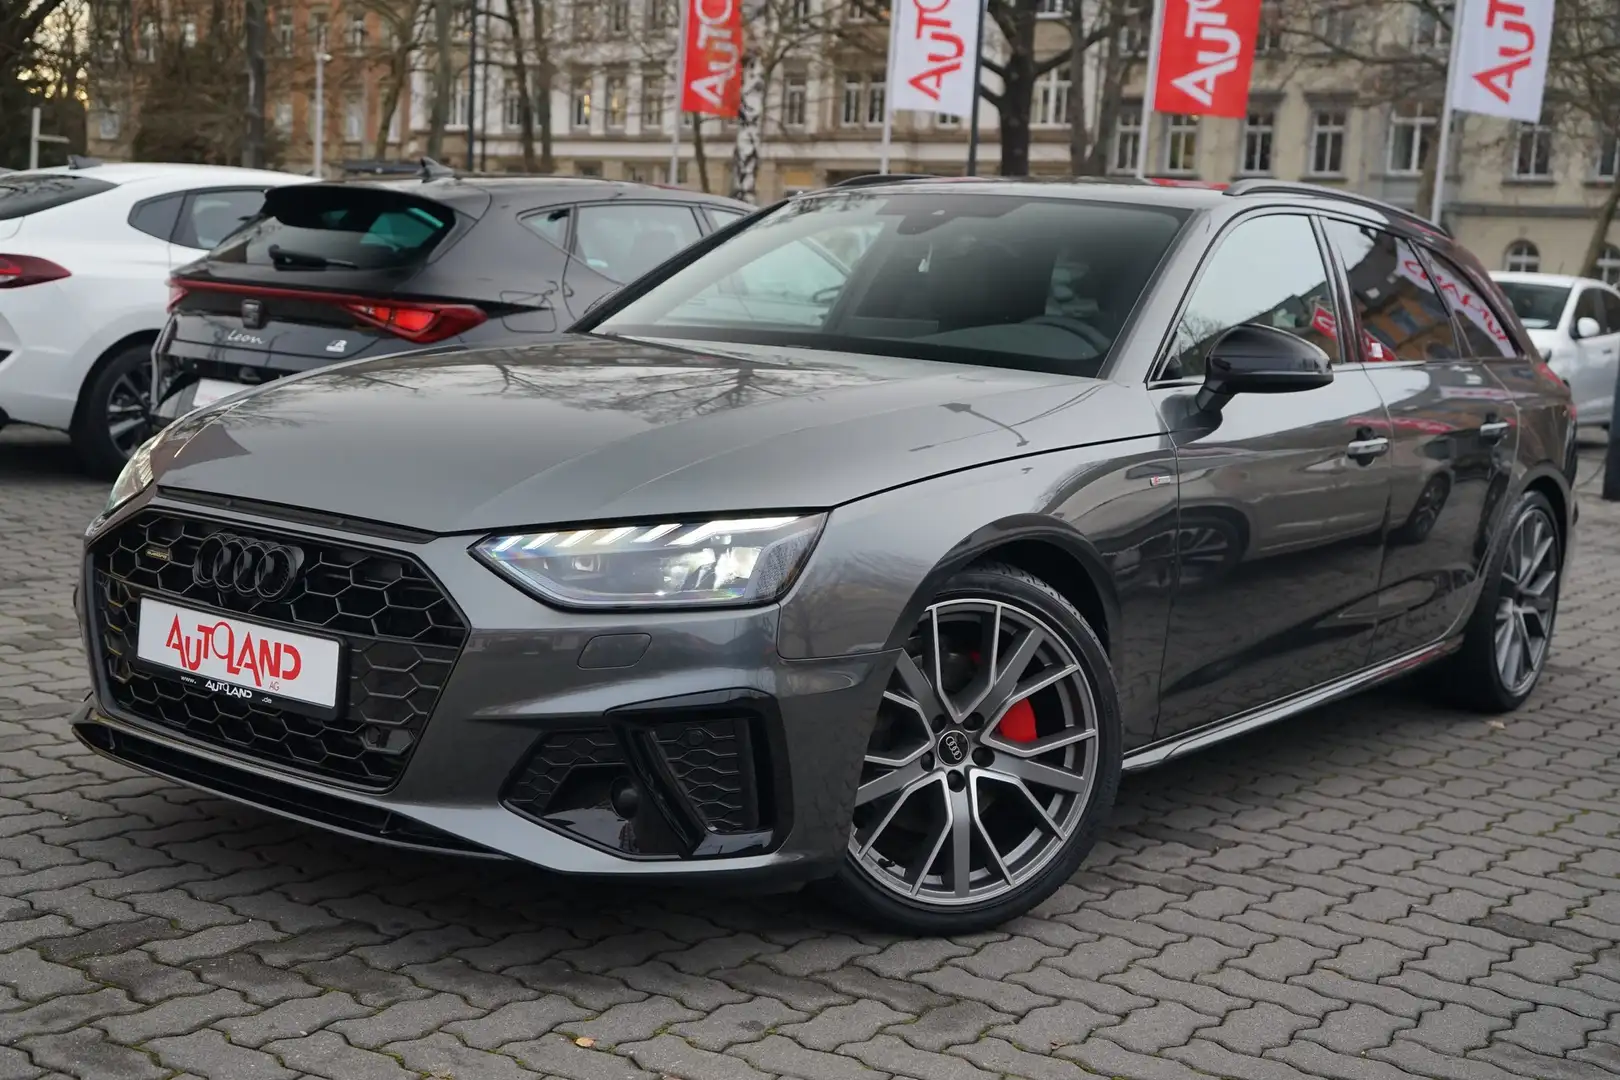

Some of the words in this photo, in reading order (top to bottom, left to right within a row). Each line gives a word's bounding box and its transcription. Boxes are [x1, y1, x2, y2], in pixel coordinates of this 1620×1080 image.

[908, 0, 965, 100] AUT
[1172, 0, 1242, 106] AUT
[227, 329, 264, 345] Leon
[166, 614, 301, 687] AUTOLAND
[181, 675, 197, 684] www.
[205, 680, 252, 698] AUTOLAND
[262, 696, 272, 704] .de
[268, 681, 279, 691] AG
